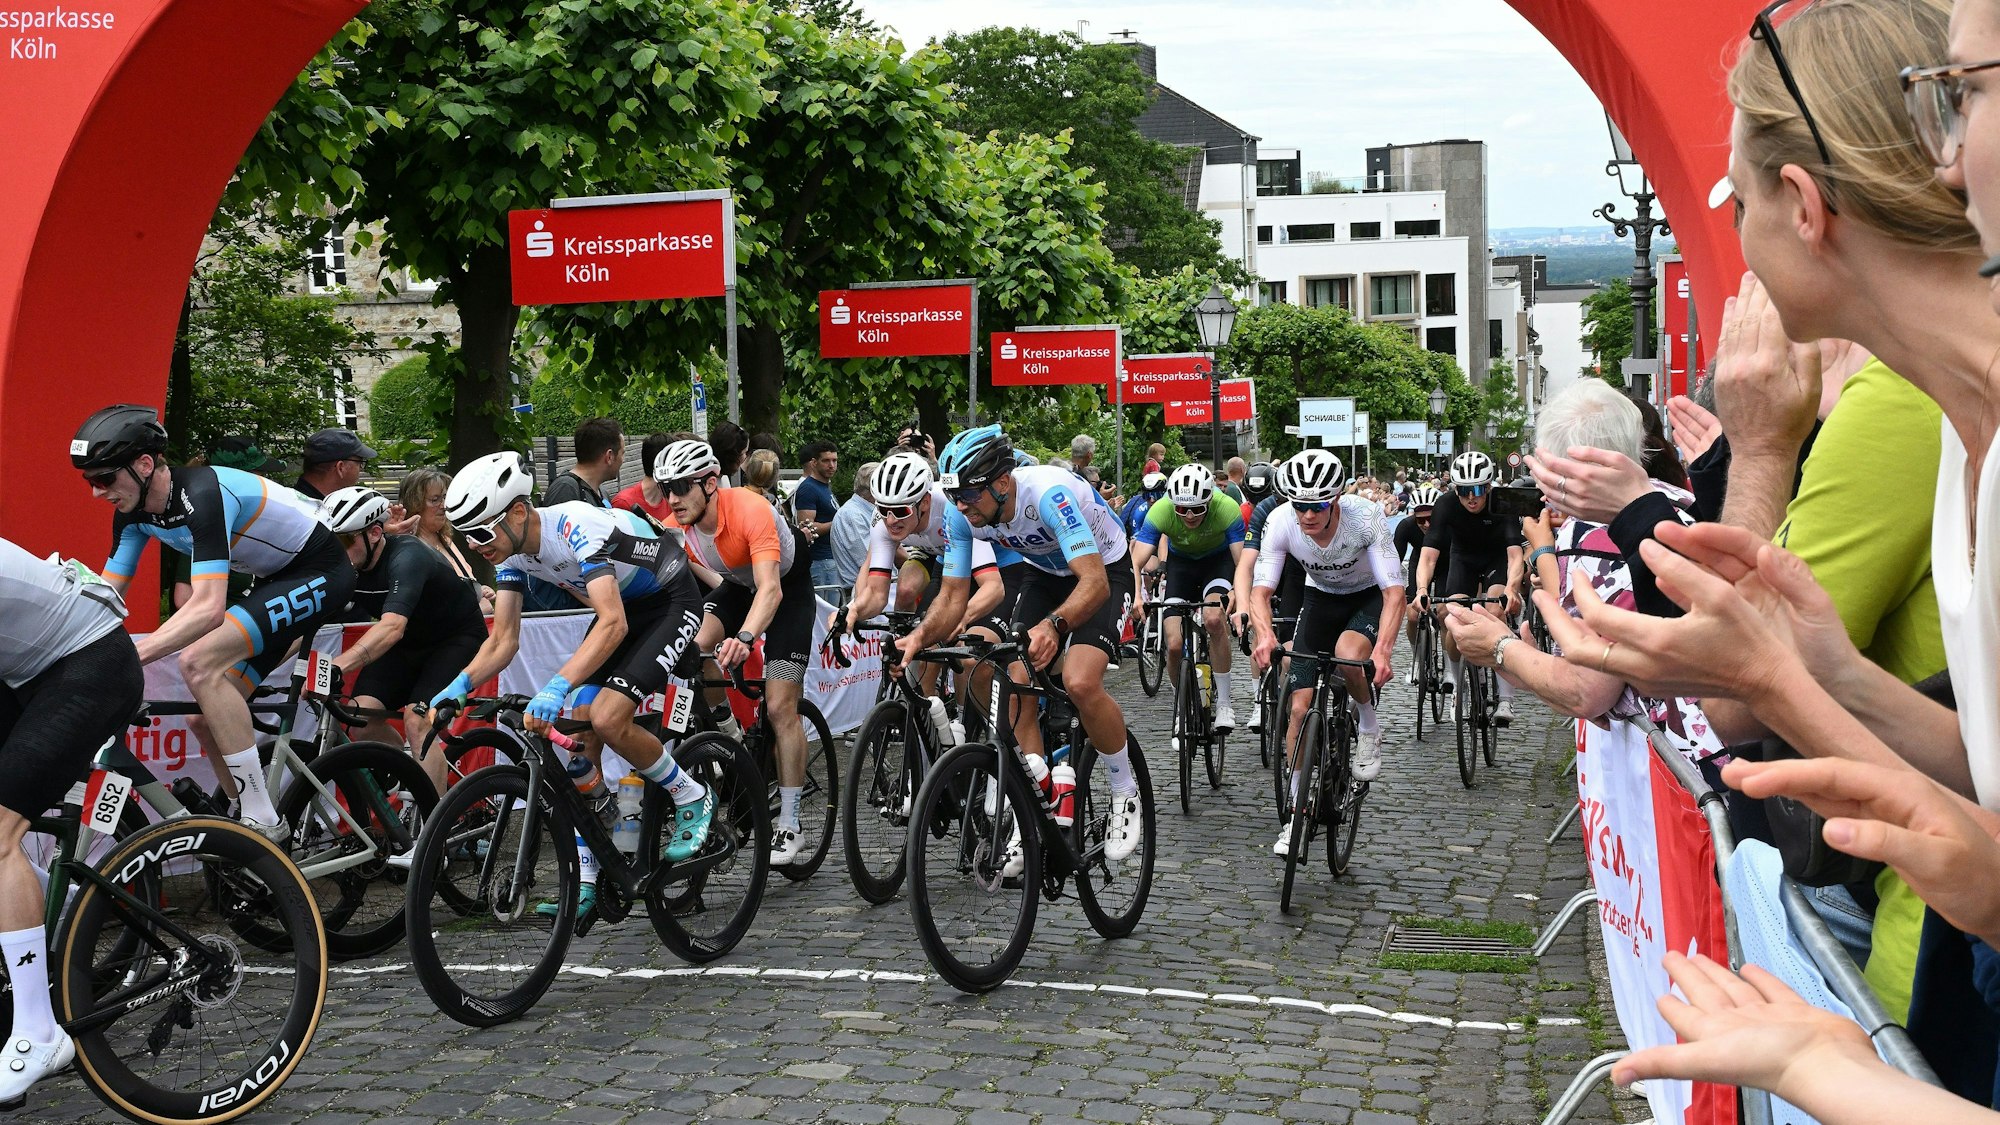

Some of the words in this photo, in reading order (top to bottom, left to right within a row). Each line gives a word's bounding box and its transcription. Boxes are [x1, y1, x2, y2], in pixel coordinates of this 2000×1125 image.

[10, 36, 57, 59] Köln
[564, 232, 713, 257] Kreissparkasse
[565, 263, 610, 283] Köln
[857, 308, 963, 325] Kreissparkasse
[857, 329, 889, 343] Köln
[1022, 346, 1110, 361] Kreissparkasse
[1022, 363, 1049, 375] Köln
[1133, 385, 1156, 395] Köln
[1186, 408, 1205, 417] Köln
[1304, 414, 1346, 422] SCHWALBE
[633, 540, 660, 557] Mobil
[265, 576, 326, 634] RSF
[656, 609, 701, 673] Mobil
[318, 659, 329, 688] 6349
[672, 694, 689, 725] 6784
[95, 782, 124, 824] 6952
[125, 974, 201, 1013] SPECIALIZED
[198, 1039, 290, 1114] roval
